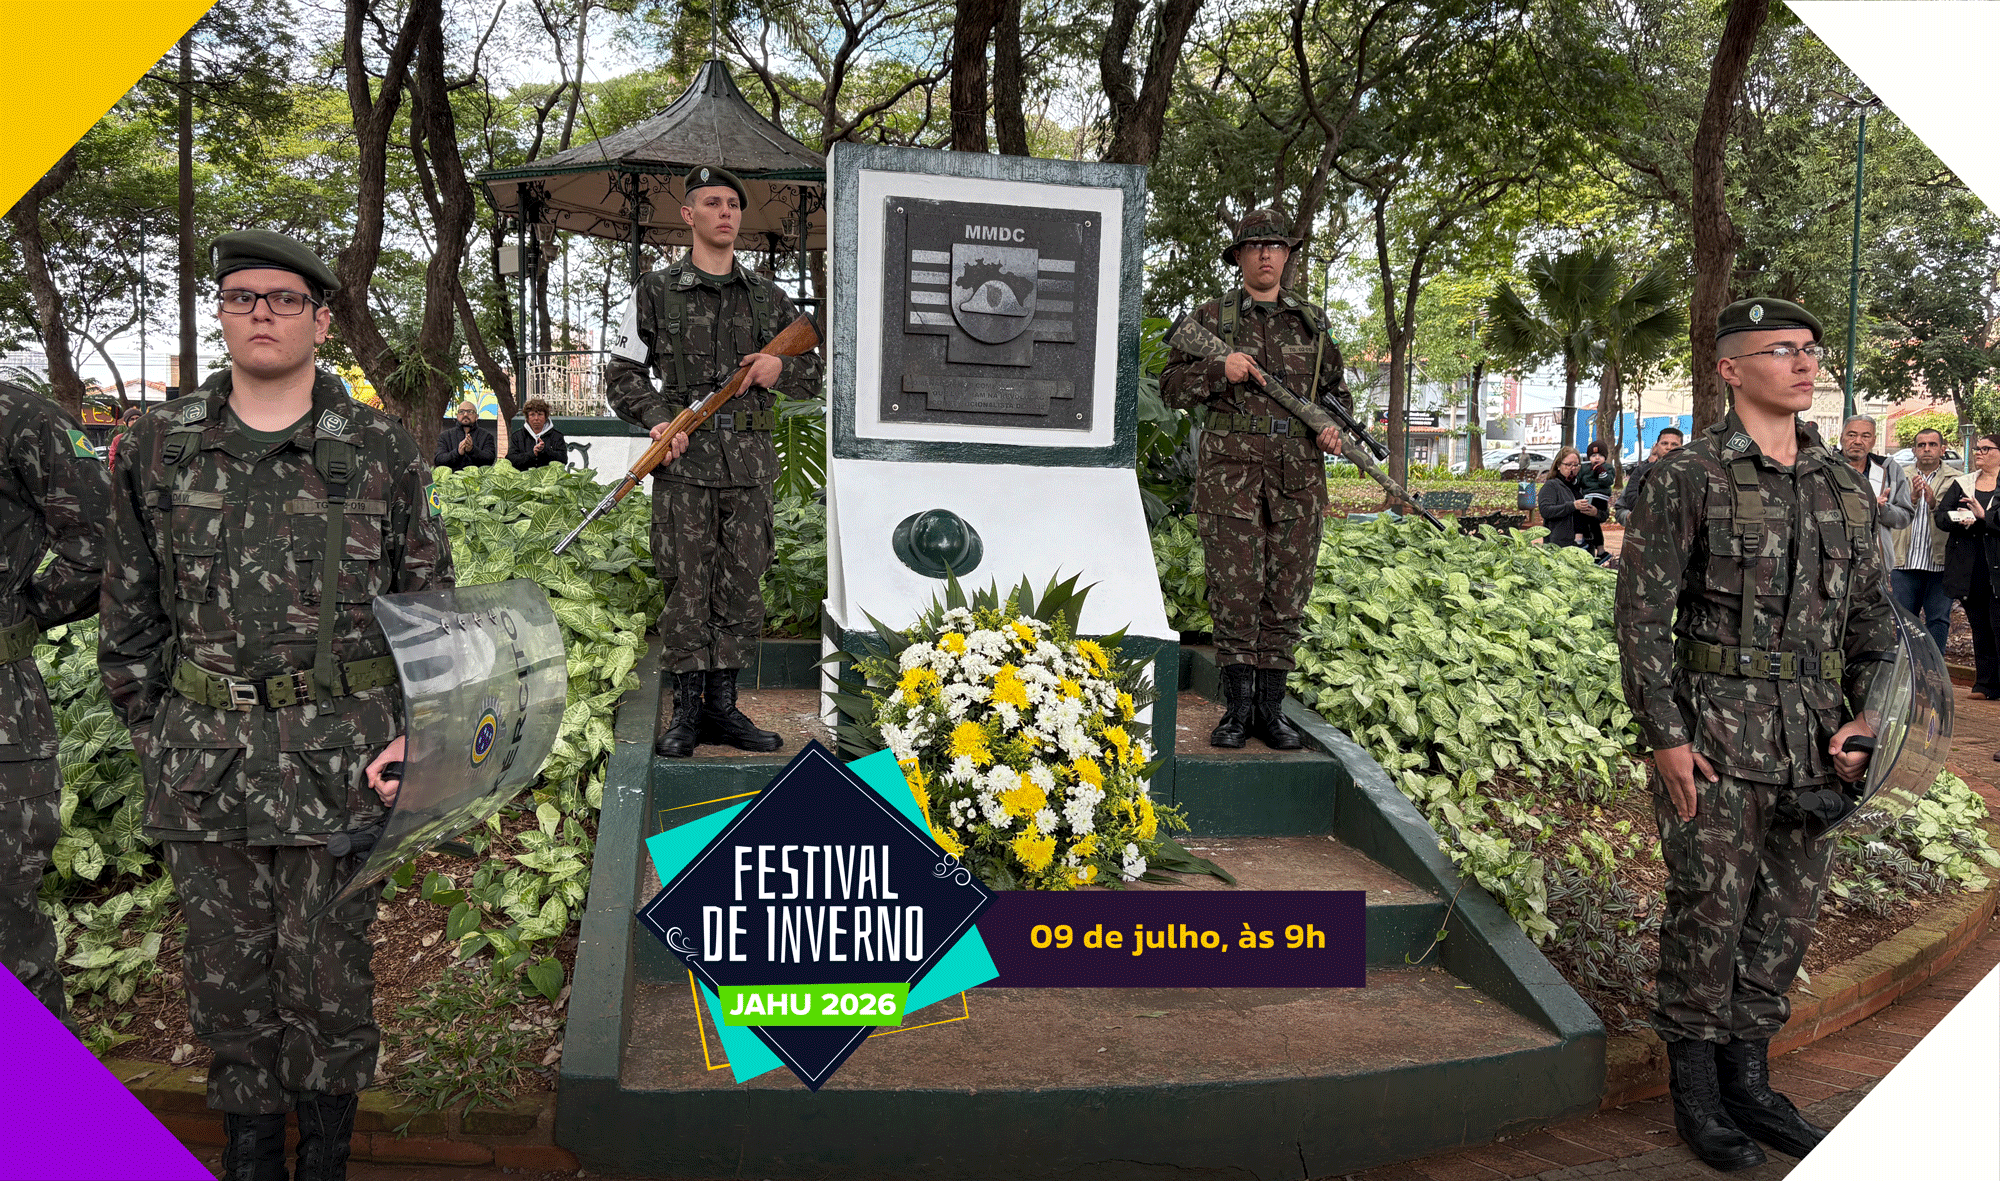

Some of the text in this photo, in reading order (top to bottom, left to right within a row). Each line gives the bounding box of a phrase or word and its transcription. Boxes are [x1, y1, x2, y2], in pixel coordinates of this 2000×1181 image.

[965, 224, 1025, 243] MMDC
[314, 501, 329, 510] TG
[483, 610, 531, 800] XÉRCITO
